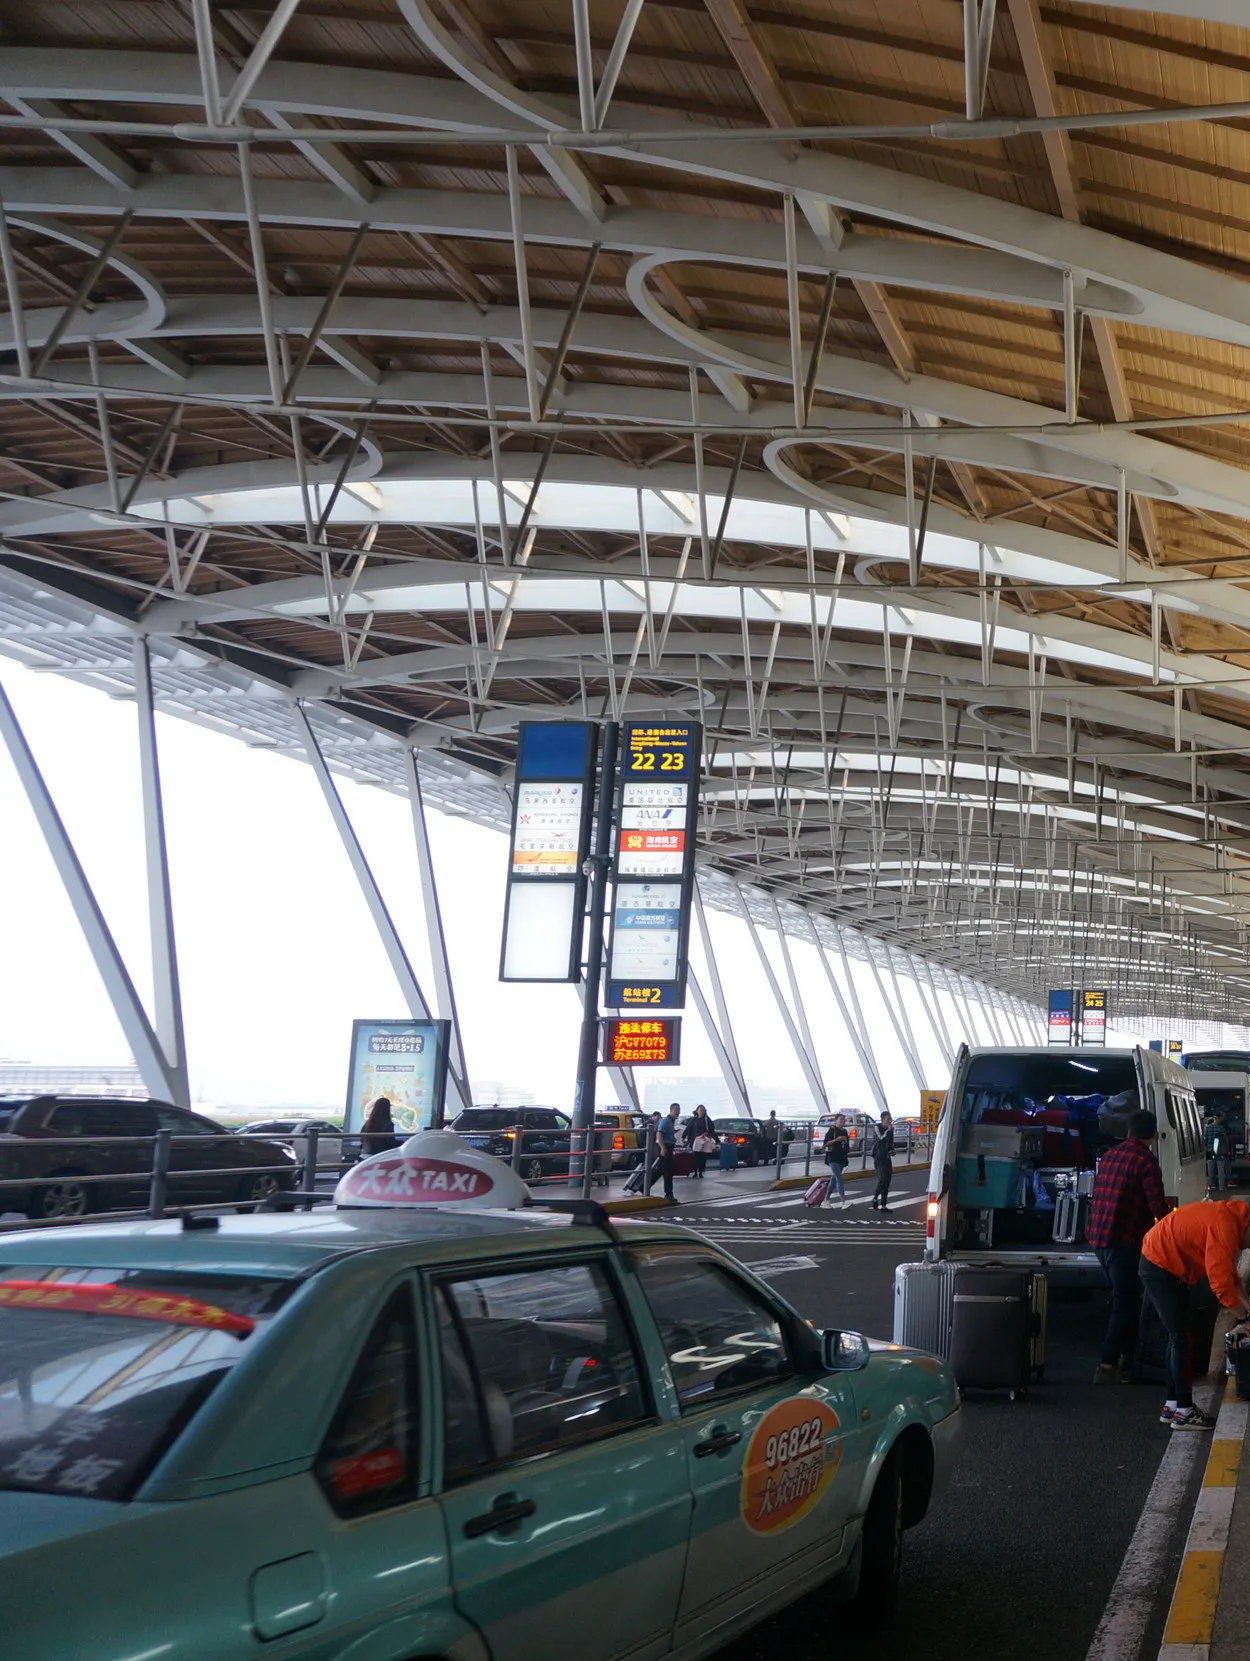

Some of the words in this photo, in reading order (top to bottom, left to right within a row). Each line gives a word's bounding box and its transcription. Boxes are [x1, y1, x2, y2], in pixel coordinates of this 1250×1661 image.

[631, 753, 655, 770] 22
[661, 753, 684, 770] 23
[635, 810, 660, 819] ANA
[623, 988, 651, 996] 航站楼
[650, 988, 661, 1003] 2
[619, 1022, 663, 1034] 违法停车
[357, 1162, 417, 1196] 大众
[421, 1170, 479, 1193] TAXI
[765, 1417, 823, 1469] 96822
[755, 1455, 824, 1520] 大众出行
